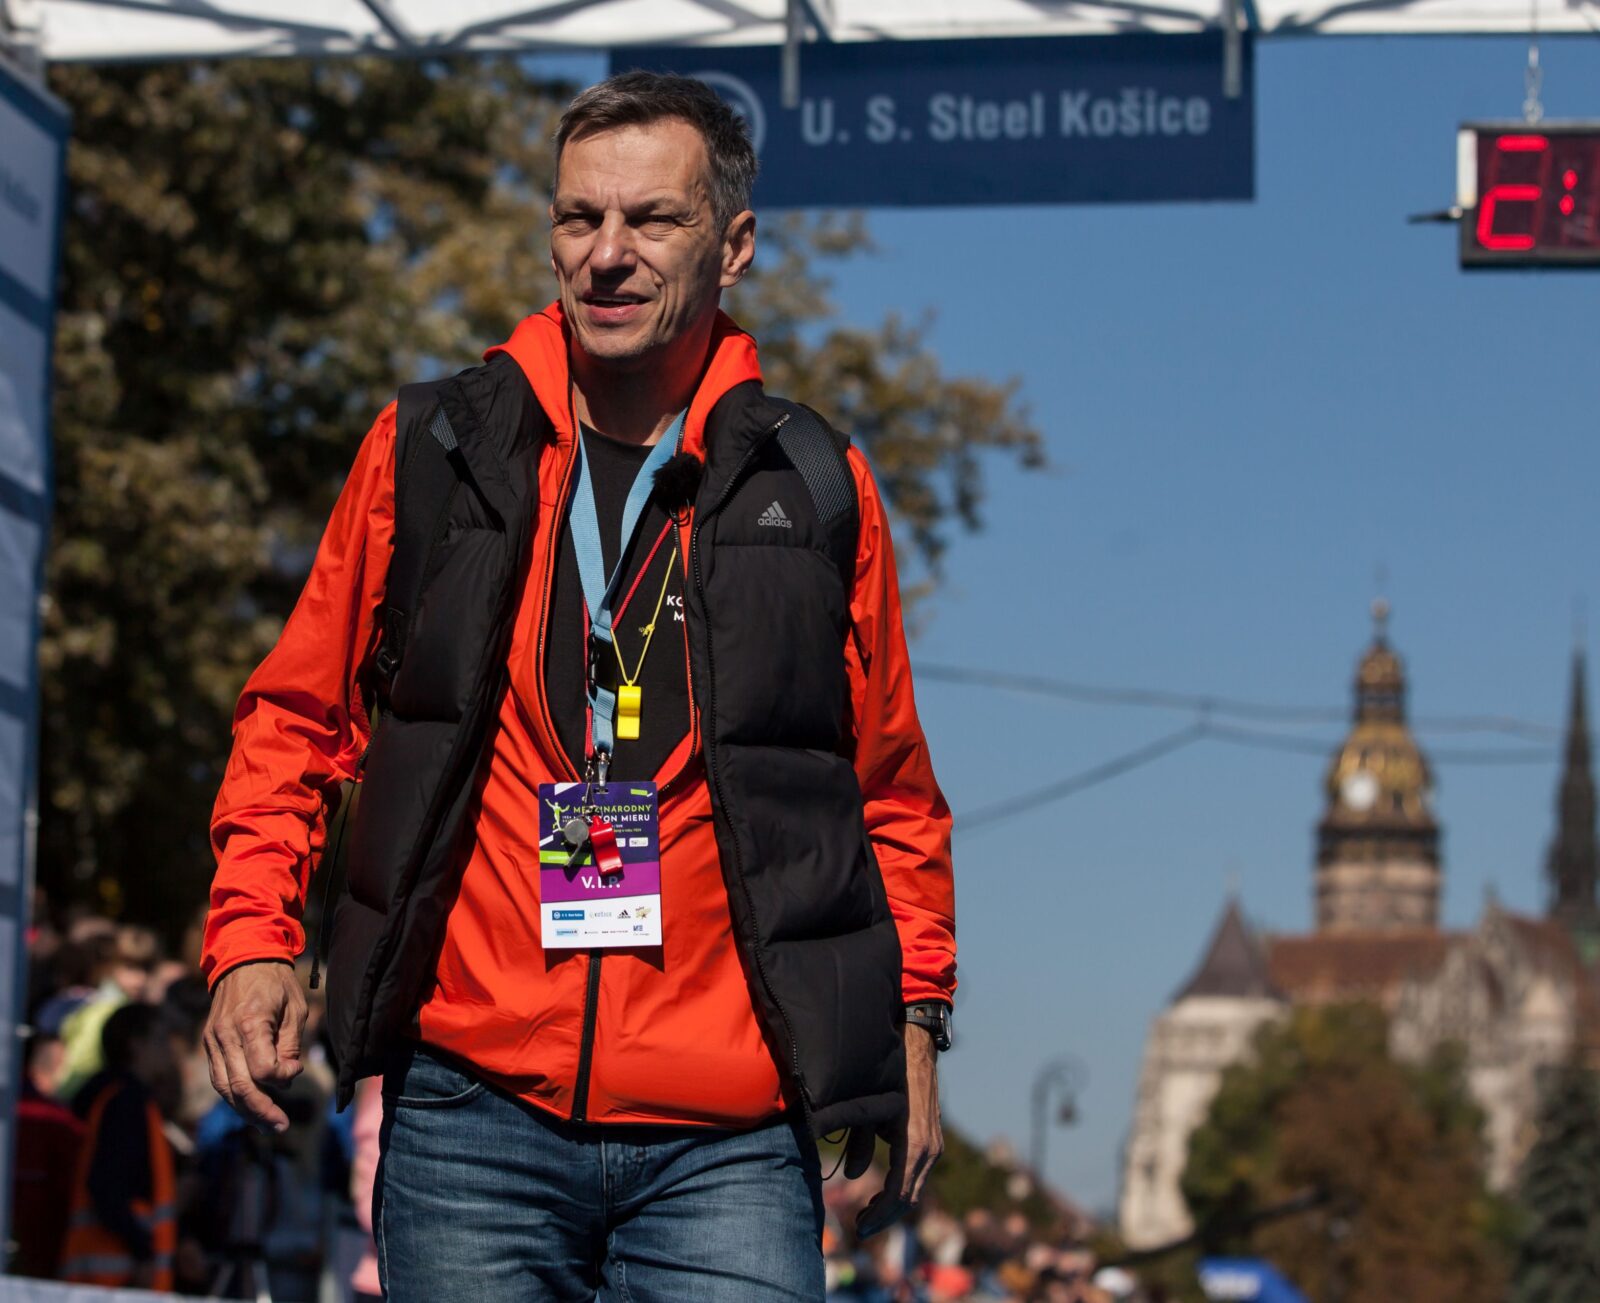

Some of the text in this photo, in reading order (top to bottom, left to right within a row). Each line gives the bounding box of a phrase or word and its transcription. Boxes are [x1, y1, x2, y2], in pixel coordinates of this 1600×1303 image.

[802, 86, 1210, 145] U. S. Steel Košice
[757, 517, 793, 529] adidas
[621, 814, 650, 822] MIERU
